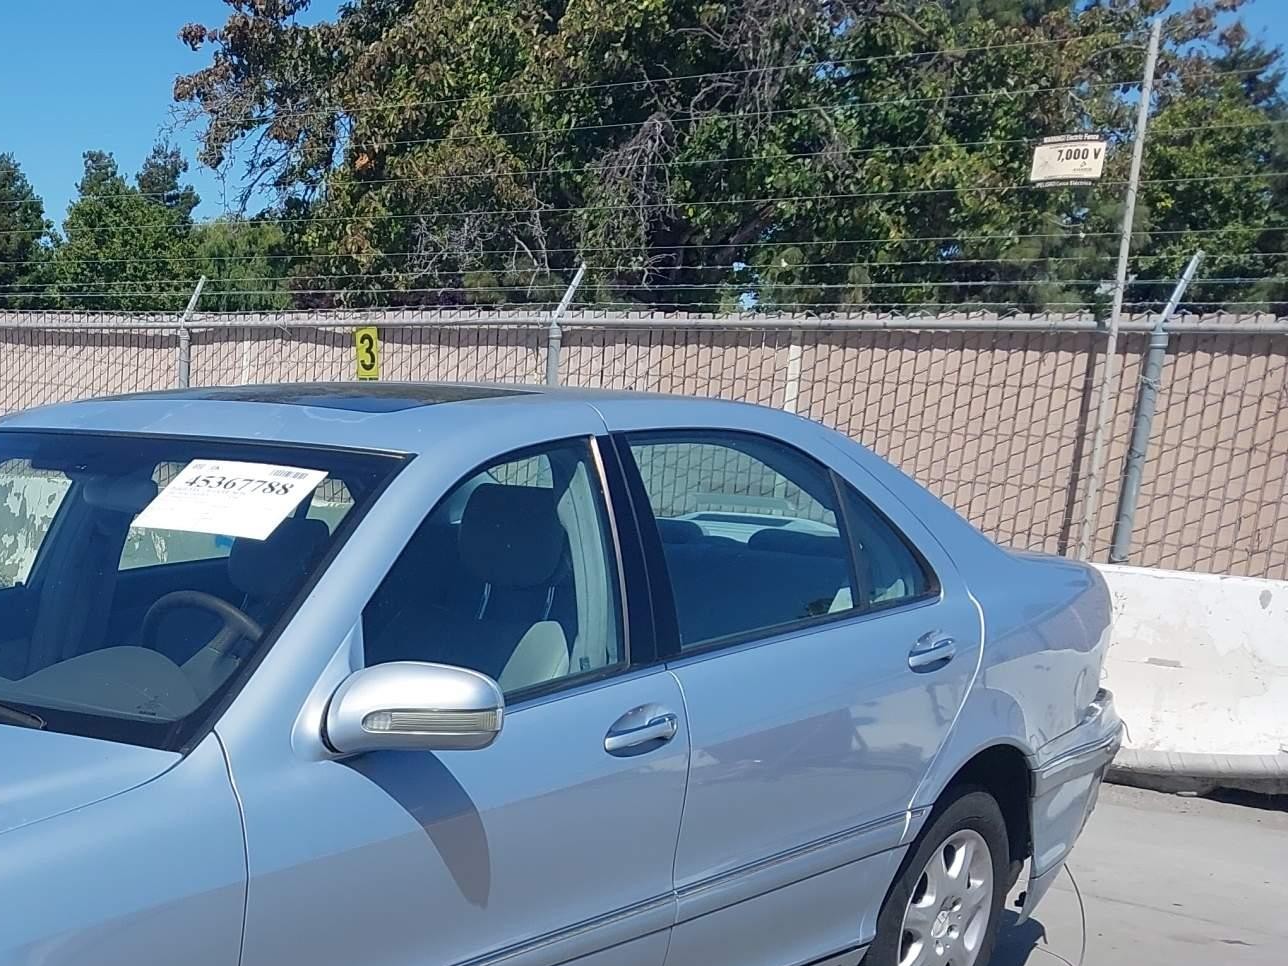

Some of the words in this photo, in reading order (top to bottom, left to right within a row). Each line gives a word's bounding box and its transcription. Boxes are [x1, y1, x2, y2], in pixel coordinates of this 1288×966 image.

[1057, 148, 1089, 162] 7,000
[1094, 148, 1101, 160] V
[360, 333, 376, 371] 3
[185, 474, 294, 496] 45367788
